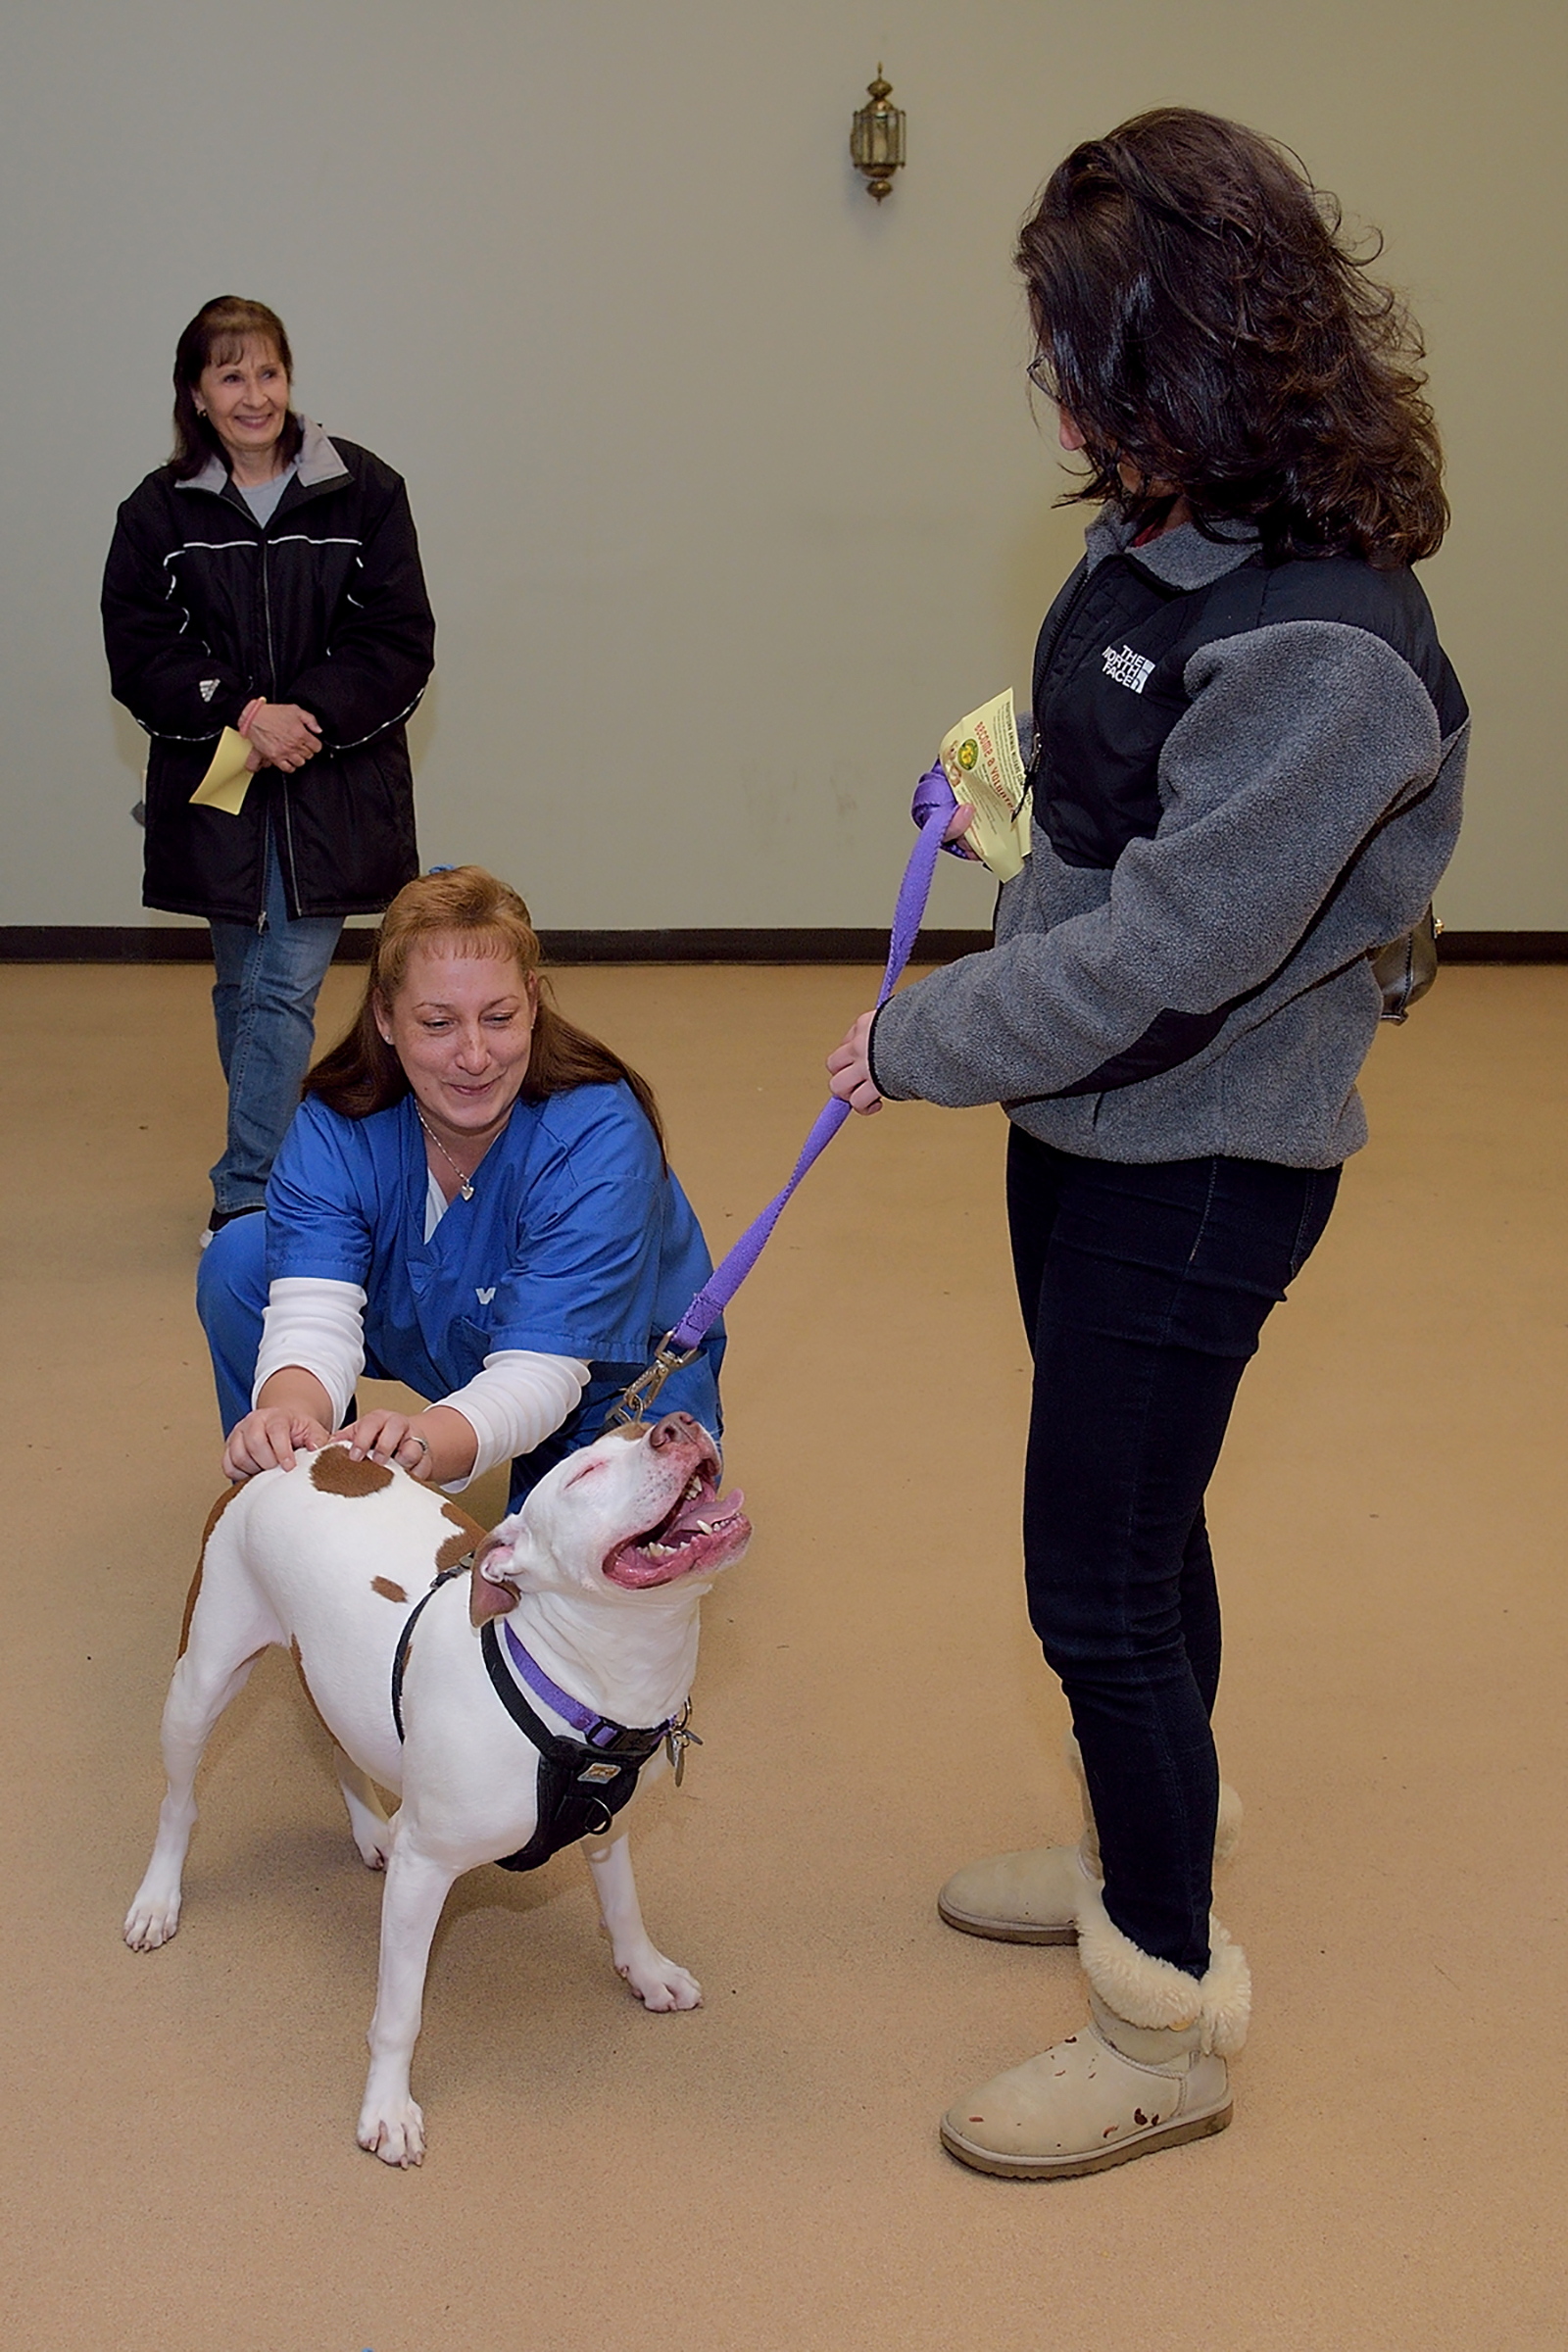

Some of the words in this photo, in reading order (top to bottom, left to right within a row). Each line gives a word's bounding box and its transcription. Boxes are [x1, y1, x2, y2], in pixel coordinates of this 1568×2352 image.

[1102, 647, 1140, 677] NORTH
[1121, 645, 1147, 668] THE
[1102, 662, 1134, 687] FACE
